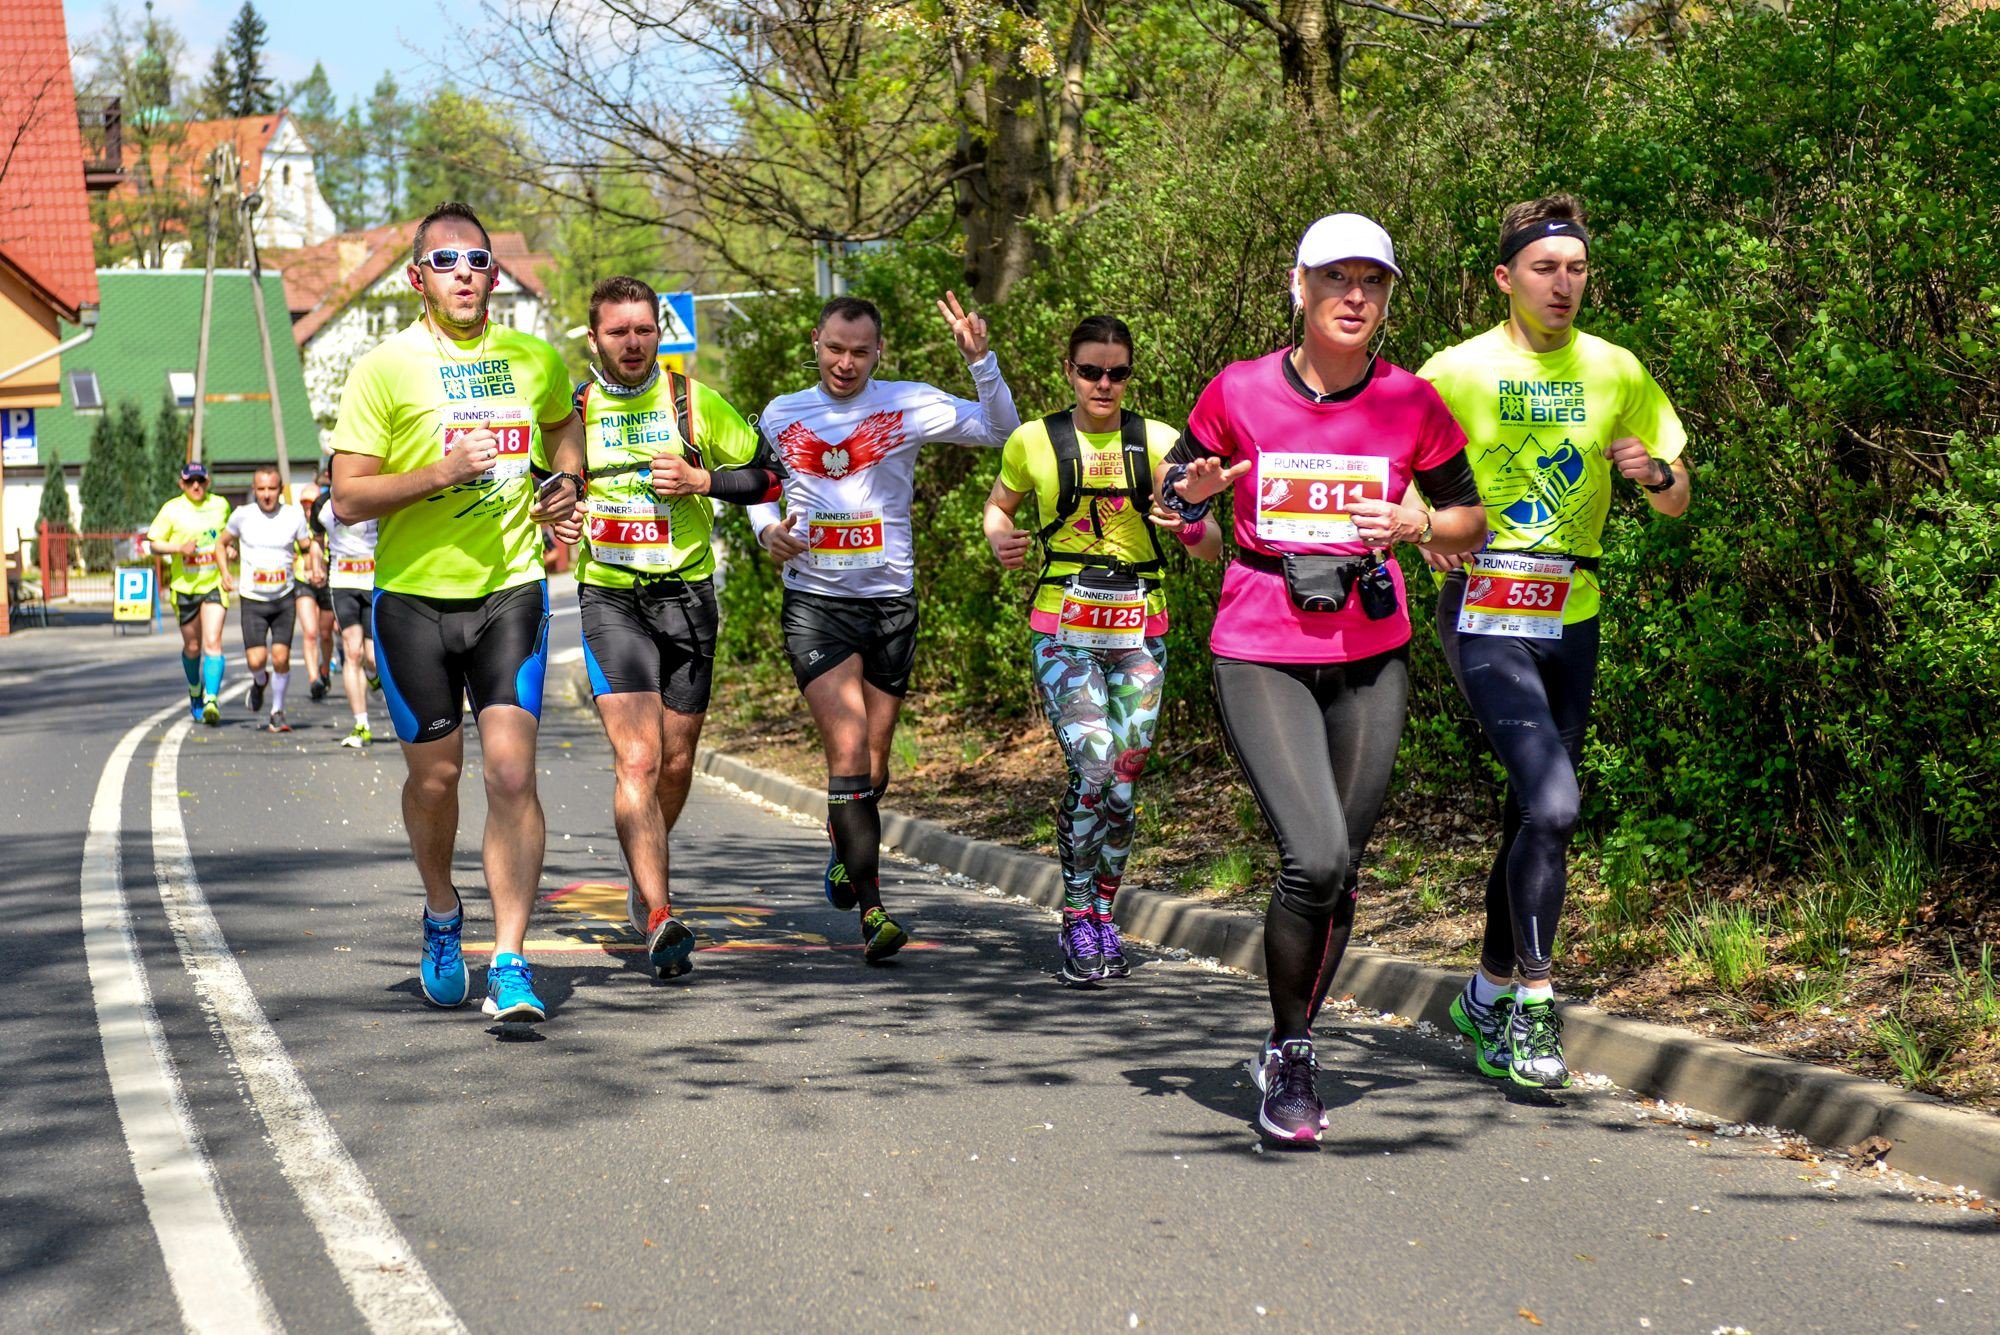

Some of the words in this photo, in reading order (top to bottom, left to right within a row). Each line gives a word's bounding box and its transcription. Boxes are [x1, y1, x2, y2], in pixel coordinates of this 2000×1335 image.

[468, 374, 512, 386] SUPER
[471, 382, 516, 399] BIEG
[1530, 398, 1585, 407] SUPER
[9, 409, 30, 438] P
[1531, 407, 1586, 422] BIEG
[495, 429, 520, 452] 18
[627, 430, 670, 445] BIEG
[1089, 467, 1123, 476] BIEG
[617, 521, 659, 542] 736
[836, 526, 874, 547] 763
[123, 573, 144, 600] P
[1507, 582, 1555, 607] 553
[1089, 607, 1142, 627] 1125
